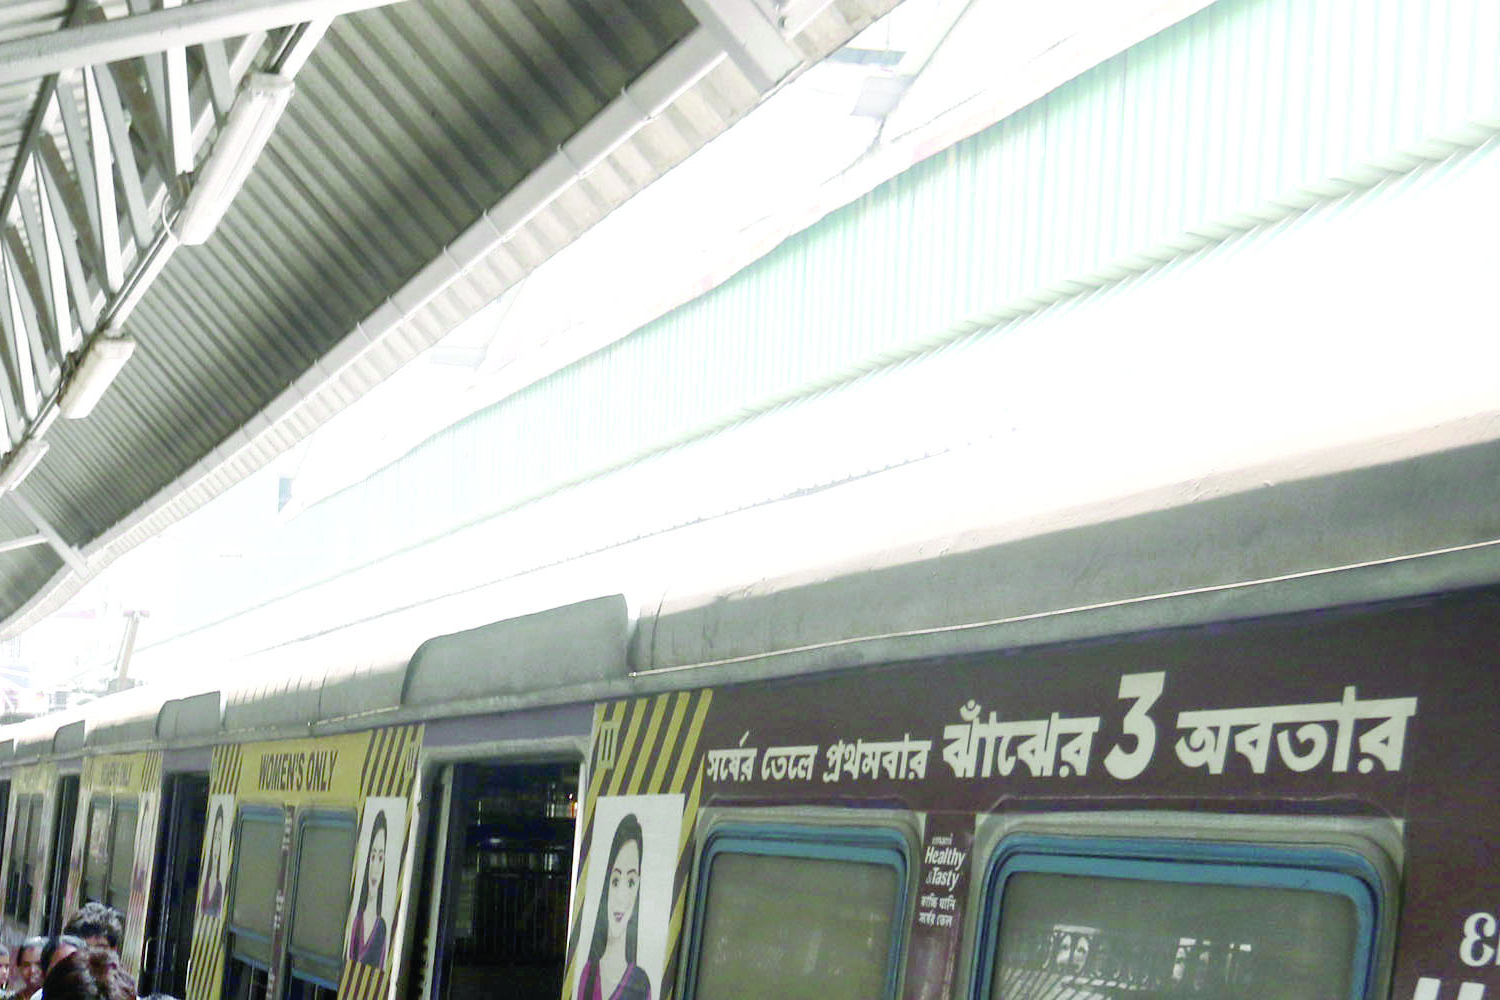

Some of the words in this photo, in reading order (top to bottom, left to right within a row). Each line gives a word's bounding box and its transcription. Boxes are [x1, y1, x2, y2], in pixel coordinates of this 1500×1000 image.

[706, 730, 758, 781] সর্ষের
[761, 745, 819, 781] তেলে
[823, 733, 932, 783] প্রথমবার
[1103, 671, 1166, 780] 3
[1175, 685, 1418, 775] অবতার
[258, 752, 305, 792] WOMEN'S
[306, 749, 339, 792] ONLY
[925, 846, 965, 871] Healthy
